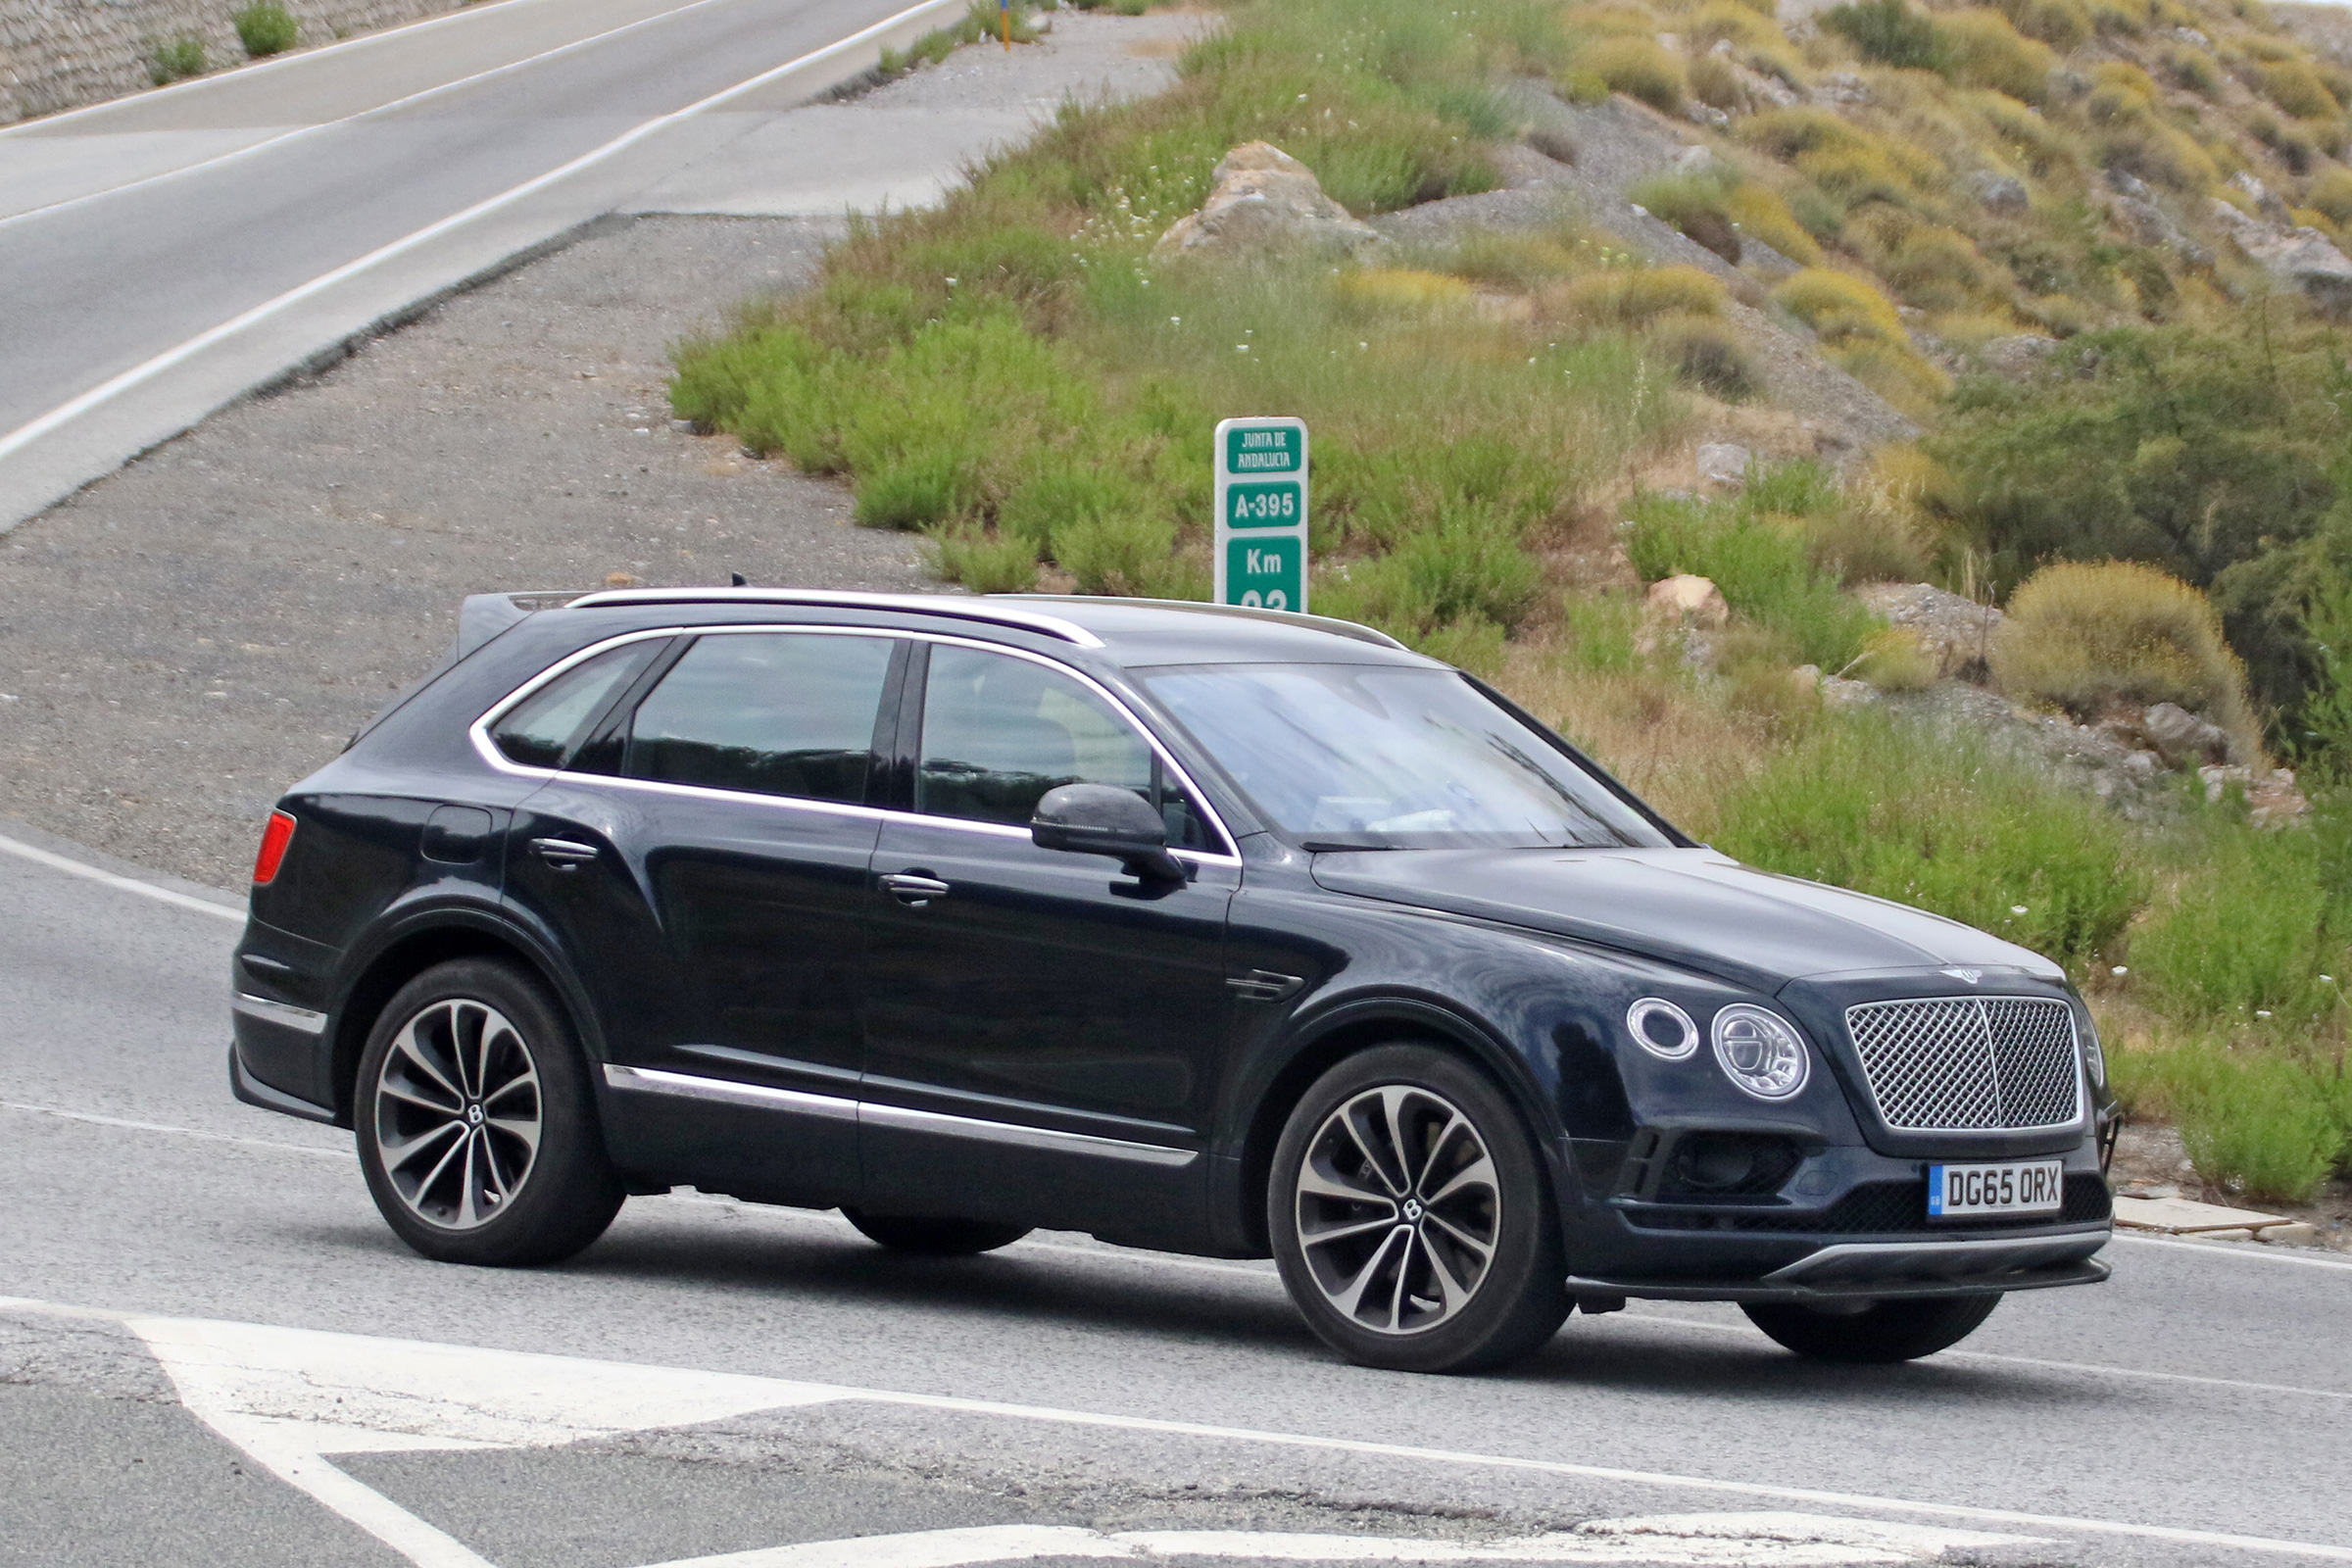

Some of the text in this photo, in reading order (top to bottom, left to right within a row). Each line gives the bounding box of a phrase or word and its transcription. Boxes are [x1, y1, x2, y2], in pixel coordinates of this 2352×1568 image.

[1242, 431, 1287, 447] JUNTA DE
[1235, 492, 1294, 517] A-395
[1247, 548, 1282, 574] Km
[1948, 1166, 2059, 1206] DG65 ORX
